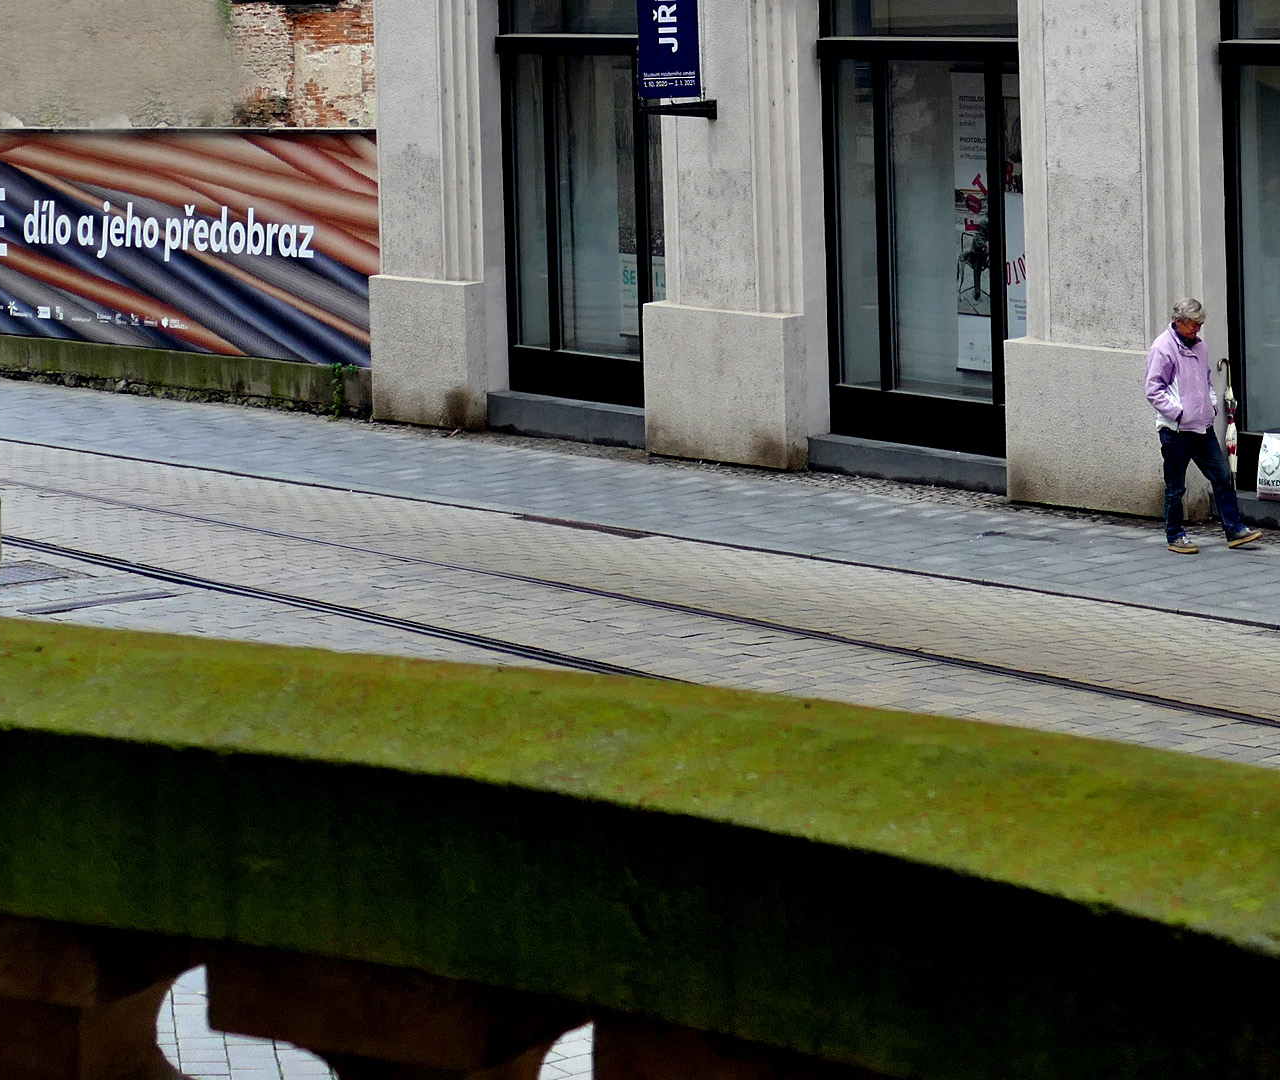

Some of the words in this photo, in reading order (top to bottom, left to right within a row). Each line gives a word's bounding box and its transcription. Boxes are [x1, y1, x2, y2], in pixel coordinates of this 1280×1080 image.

[23, 200, 71, 245] dílo
[77, 214, 94, 247] a
[97, 200, 159, 259] jeho
[164, 204, 315, 262] předobraz
